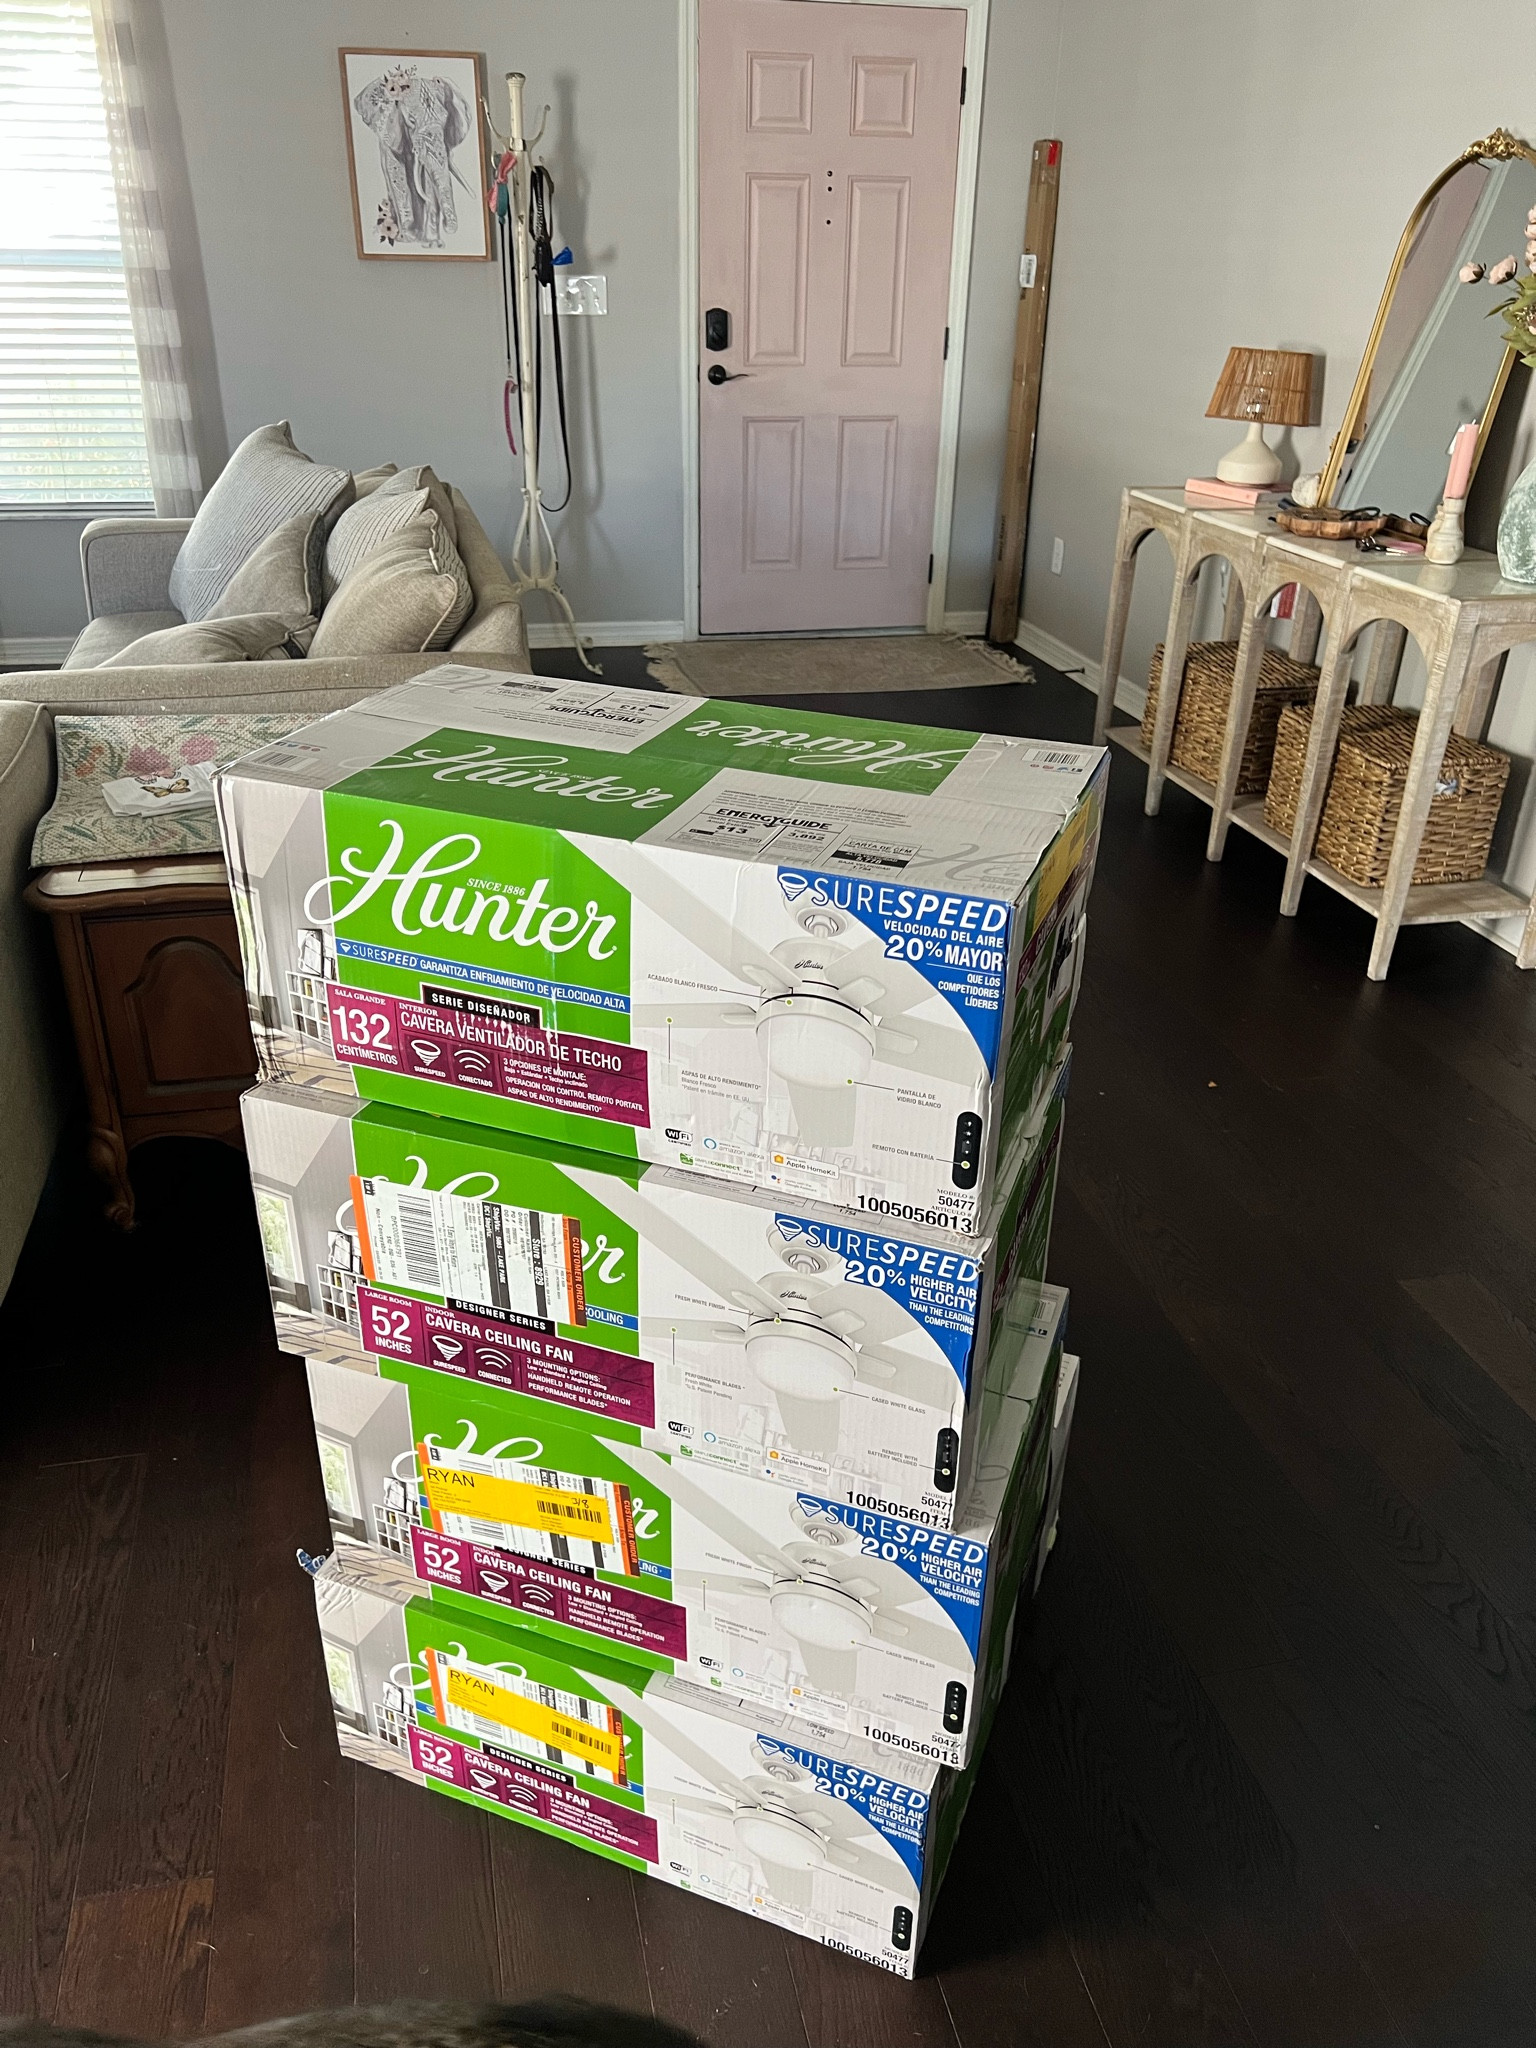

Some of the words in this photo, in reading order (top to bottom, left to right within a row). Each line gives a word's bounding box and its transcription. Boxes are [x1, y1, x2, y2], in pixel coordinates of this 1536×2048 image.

[685, 720, 1001, 773] Hunter
[338, 745, 674, 809] Hunter
[716, 809, 832, 830] ENERGYGUIDE
[304, 820, 617, 960] Hunter
[466, 878, 501, 892] SINCE
[502, 884, 526, 896] 1886
[811, 877, 1007, 932] SURESPEED
[884, 919, 947, 939] VELOCIDAD
[951, 929, 972, 944] DEL
[976, 935, 1004, 949] AIRE
[886, 935, 943, 961] 20%
[945, 945, 1003, 972] MAYOR
[352, 945, 416, 967] SURESPEED
[420, 958, 468, 979] GARANTIZA
[470, 970, 535, 991] ENFRIAMIENTO
[537, 983, 549, 994] DE
[550, 987, 602, 1004] VELOCIDAD
[604, 997, 625, 1010] ALTA
[647, 973, 673, 984] ACABADO
[674, 978, 696, 989] BLANCO
[696, 982, 718, 992] FRESCO
[938, 980, 999, 999] COMPETIDORES
[967, 973, 983, 985] QUE
[984, 976, 1001, 987] LOS
[334, 988, 353, 999] SALA
[354, 993, 386, 1006] GRANDE
[432, 993, 463, 1008] SERIE
[467, 1001, 531, 1023] DISEÑADOR
[965, 995, 998, 1011] LÍDERES
[399, 1003, 438, 1017] INTERIOR
[333, 1005, 393, 1050] 132
[401, 1011, 455, 1037] CAVERA
[457, 1022, 545, 1057] VENTILADOR
[550, 1045, 569, 1061] DE
[573, 1048, 622, 1072] TECHO
[337, 1044, 398, 1065] CENTÍMETROS
[413, 1066, 446, 1078] SURESPEED
[458, 1074, 493, 1088] CONECTADO
[503, 1057, 508, 1065] 3
[509, 1059, 542, 1073] OPCIONES
[542, 1065, 552, 1074] DE
[553, 1067, 587, 1081] MONTAJE:
[505, 1076, 541, 1090] OPERACION
[541, 1083, 555, 1093] CON
[556, 1087, 587, 1100] CONTROL
[587, 1093, 614, 1105] REMOTO
[615, 1099, 644, 1112] PORTATIL
[507, 1087, 528, 1097] ASPAS
[529, 1091, 538, 1100] DE
[539, 1094, 554, 1103] ALTO
[896, 1096, 916, 1105] VIDRIO
[917, 1099, 941, 1109] BLANCO
[897, 1088, 927, 1099] PANTALLA
[928, 1093, 936, 1101] DE
[872, 1144, 895, 1153] REMOTO
[896, 1148, 908, 1156] CON
[786, 1160, 806, 1170] Apple
[806, 1164, 836, 1177] HomeKit
[937, 1188, 962, 1199] MODELO
[938, 1195, 975, 1211] 50477
[858, 1194, 972, 1234] 1005056013
[529, 1237, 543, 1260] Store
[572, 1236, 583, 1281] CUSTOMER
[806, 1225, 978, 1282] SURESPEED
[532, 1265, 546, 1286] 8929
[845, 1259, 906, 1288] 20%
[910, 1274, 955, 1294] HIGHER
[956, 1285, 977, 1300] AIR
[365, 1291, 388, 1301] LARGE
[389, 1297, 412, 1307] ROOM
[575, 1281, 585, 1311] ORDER
[910, 1285, 976, 1313] VELOCITY
[372, 1305, 412, 1343] 52
[425, 1306, 455, 1319] INDOOR
[456, 1301, 506, 1320] DESIGNER
[510, 1314, 546, 1330] SERIES
[909, 1301, 929, 1315] THAN
[929, 1306, 943, 1317] THE
[944, 1309, 975, 1327] LEADING
[924, 1315, 974, 1336] COMPETITORS
[375, 1336, 412, 1354] INCHES
[425, 1313, 481, 1339] CAVERA
[485, 1329, 541, 1354] CEILING
[545, 1345, 573, 1363] FAN
[433, 1360, 466, 1374] SURESPEED
[478, 1370, 512, 1385] CONNECTED
[532, 1359, 568, 1374] MOUNTING
[569, 1369, 600, 1382] OPTIONS:
[527, 1373, 563, 1388] HANDHELD
[564, 1382, 592, 1395] REMOTE
[593, 1390, 631, 1406] OPERATION
[528, 1383, 577, 1402] PERFORMANCE
[871, 1396, 889, 1406] CASED
[890, 1400, 907, 1410] WHITE
[908, 1405, 926, 1415] GLASS
[867, 1450, 891, 1460] BATTERY
[891, 1455, 918, 1467] INCLUDED
[881, 1448, 904, 1458] REMOTE
[904, 1454, 918, 1462] WITH
[427, 1468, 475, 1488] RYAN
[846, 1490, 951, 1530] 1005056013
[921, 1496, 953, 1510] 50477
[623, 1500, 633, 1537] CUSTOMER
[629, 1540, 638, 1563] ORDER
[825, 1505, 984, 1564] SURESPEED
[423, 1542, 461, 1575] 52
[862, 1537, 917, 1563] 20%
[921, 1552, 961, 1572] HIGHER
[963, 1565, 983, 1578] AIR
[427, 1567, 461, 1584] INCHES
[473, 1552, 526, 1576] CAVERA
[529, 1569, 581, 1593] CEILING
[585, 1586, 611, 1602] FAN
[920, 1574, 938, 1586] THAN
[939, 1579, 951, 1589] THE
[952, 1583, 981, 1599] LEADING
[921, 1562, 982, 1588] VELOCITY
[573, 1596, 606, 1611] MOUNTING
[607, 1606, 637, 1620] OPTIONS:
[934, 1588, 980, 1607] COMPETITORS
[568, 1607, 602, 1622] HANDHELD
[603, 1618, 629, 1630] REMOTE
[630, 1625, 665, 1642] OPERATION
[450, 1669, 495, 1696] RYAN
[418, 1738, 454, 1771] 52
[489, 1747, 533, 1769] DESIGNER
[535, 1765, 567, 1783] SERIES
[422, 1760, 454, 1779] INCHES
[464, 1752, 512, 1779] CAVERA
[515, 1771, 563, 1798] CEILING
[565, 1791, 590, 1809] FAN
[783, 1747, 926, 1810] SURESPEED
[816, 1777, 866, 1803] 20%
[869, 1794, 905, 1815] HIGHER
[908, 1808, 924, 1822] AIR
[869, 1803, 923, 1830] VELOCITY
[820, 1935, 908, 1977] 1005056013
[882, 1949, 909, 1963] 50477
